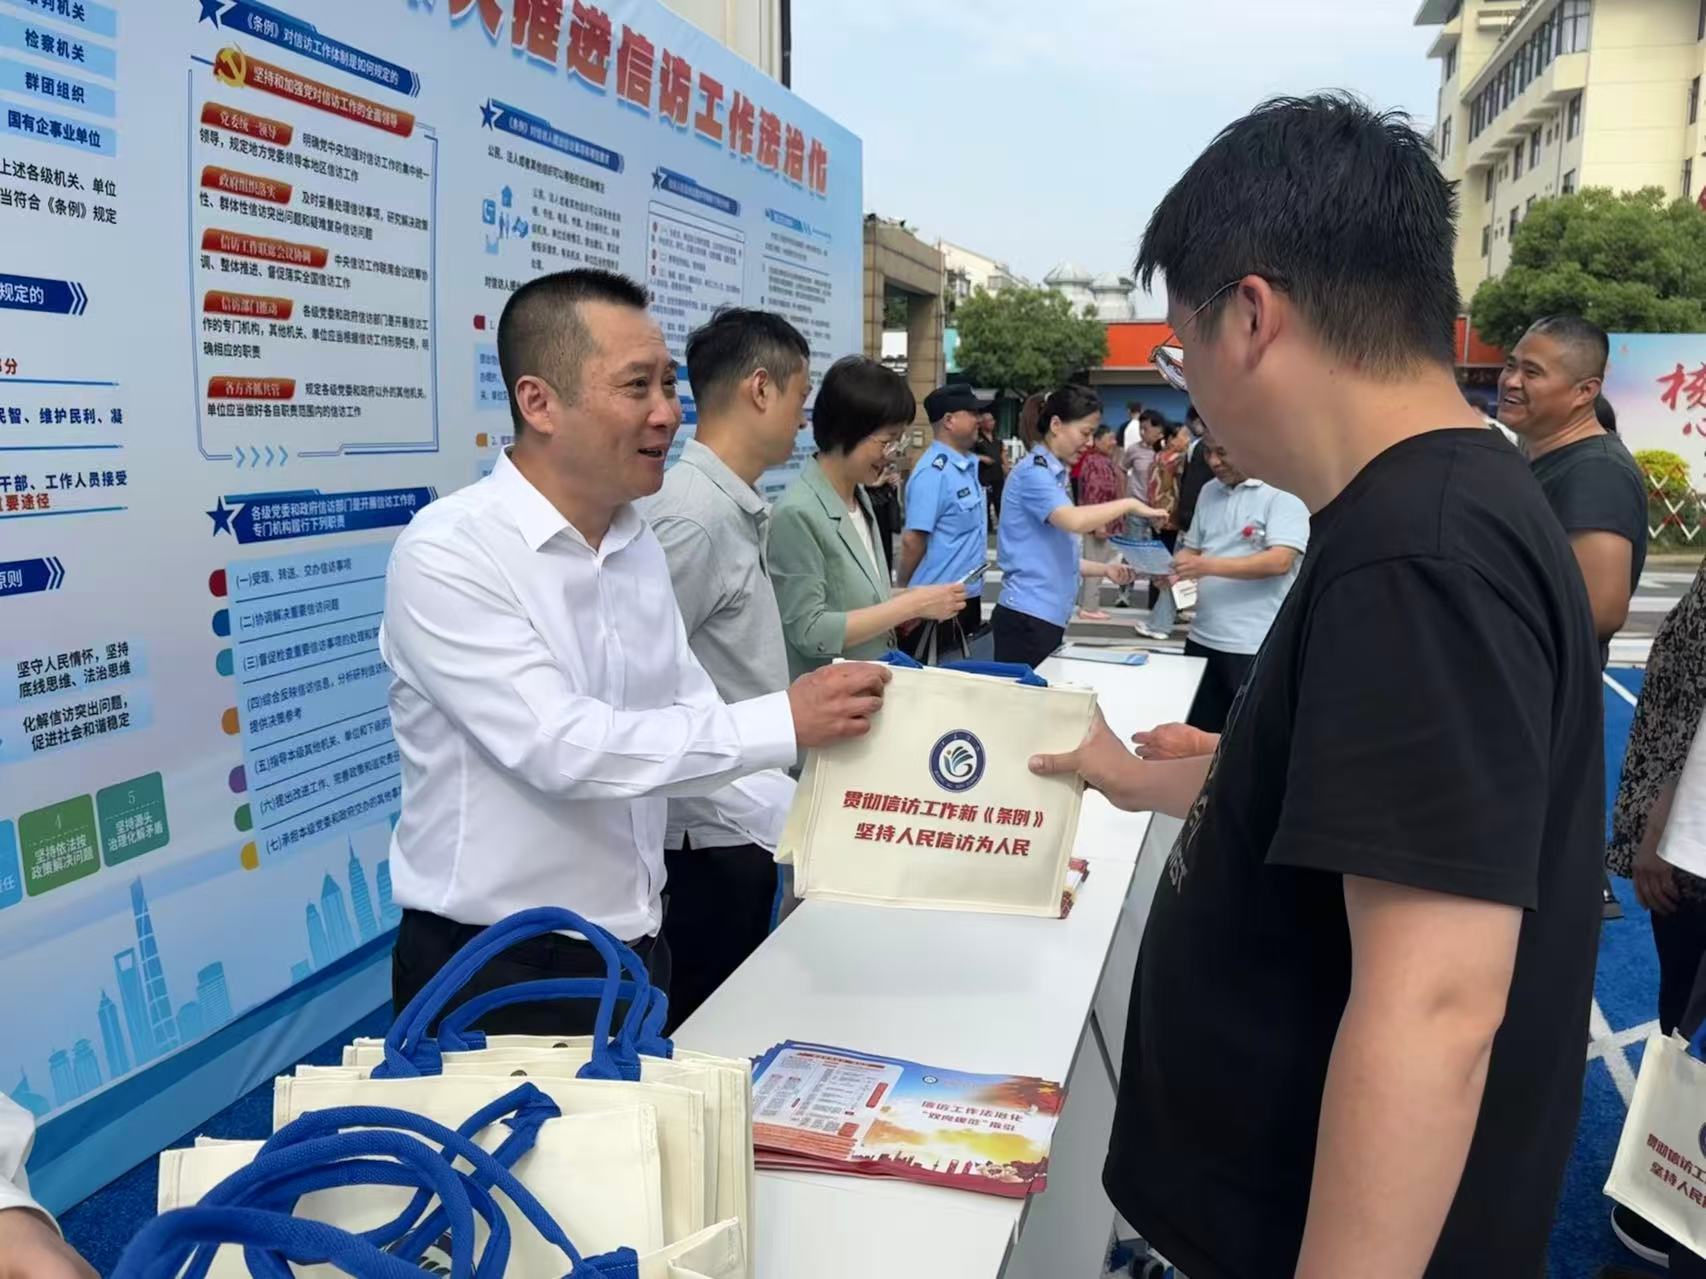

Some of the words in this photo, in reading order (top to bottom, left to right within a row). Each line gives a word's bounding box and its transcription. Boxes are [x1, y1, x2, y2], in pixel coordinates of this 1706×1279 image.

[26, 0, 86, 22] 判机关
[25, 28, 85, 63] 检察机关
[25, 71, 85, 104] 群团组织
[253, 66, 398, 129] 坚持和加强党对信访工作的全面领导
[8, 109, 101, 148] 国有企事业单位
[0, 158, 117, 197] 上述各级机关、单位
[0, 188, 117, 224] 当符合《条例》规定
[0, 282, 44, 305] 规定的
[0, 358, 18, 375] 分
[203, 341, 261, 359] 确相应的职责
[0, 471, 128, 493] 干部、工作人员接受
[0, 493, 50, 512] 要途径
[17, 641, 129, 678] 坚守人民情怀，坚持
[19, 660, 131, 699] 底线思维、法治思维
[23, 694, 128, 733] 化解信访突出问题，
[31, 712, 130, 752] 促进社会和谐稳定
[115, 811, 153, 835] 坚持源头
[843, 789, 1044, 828] 贯彻信访工作新《条例》
[854, 822, 1030, 856] 坚持人民信访为人民
[921, 1100, 1024, 1122] 信访工作法治化
[1650, 1161, 1706, 1209] 坚持人民
